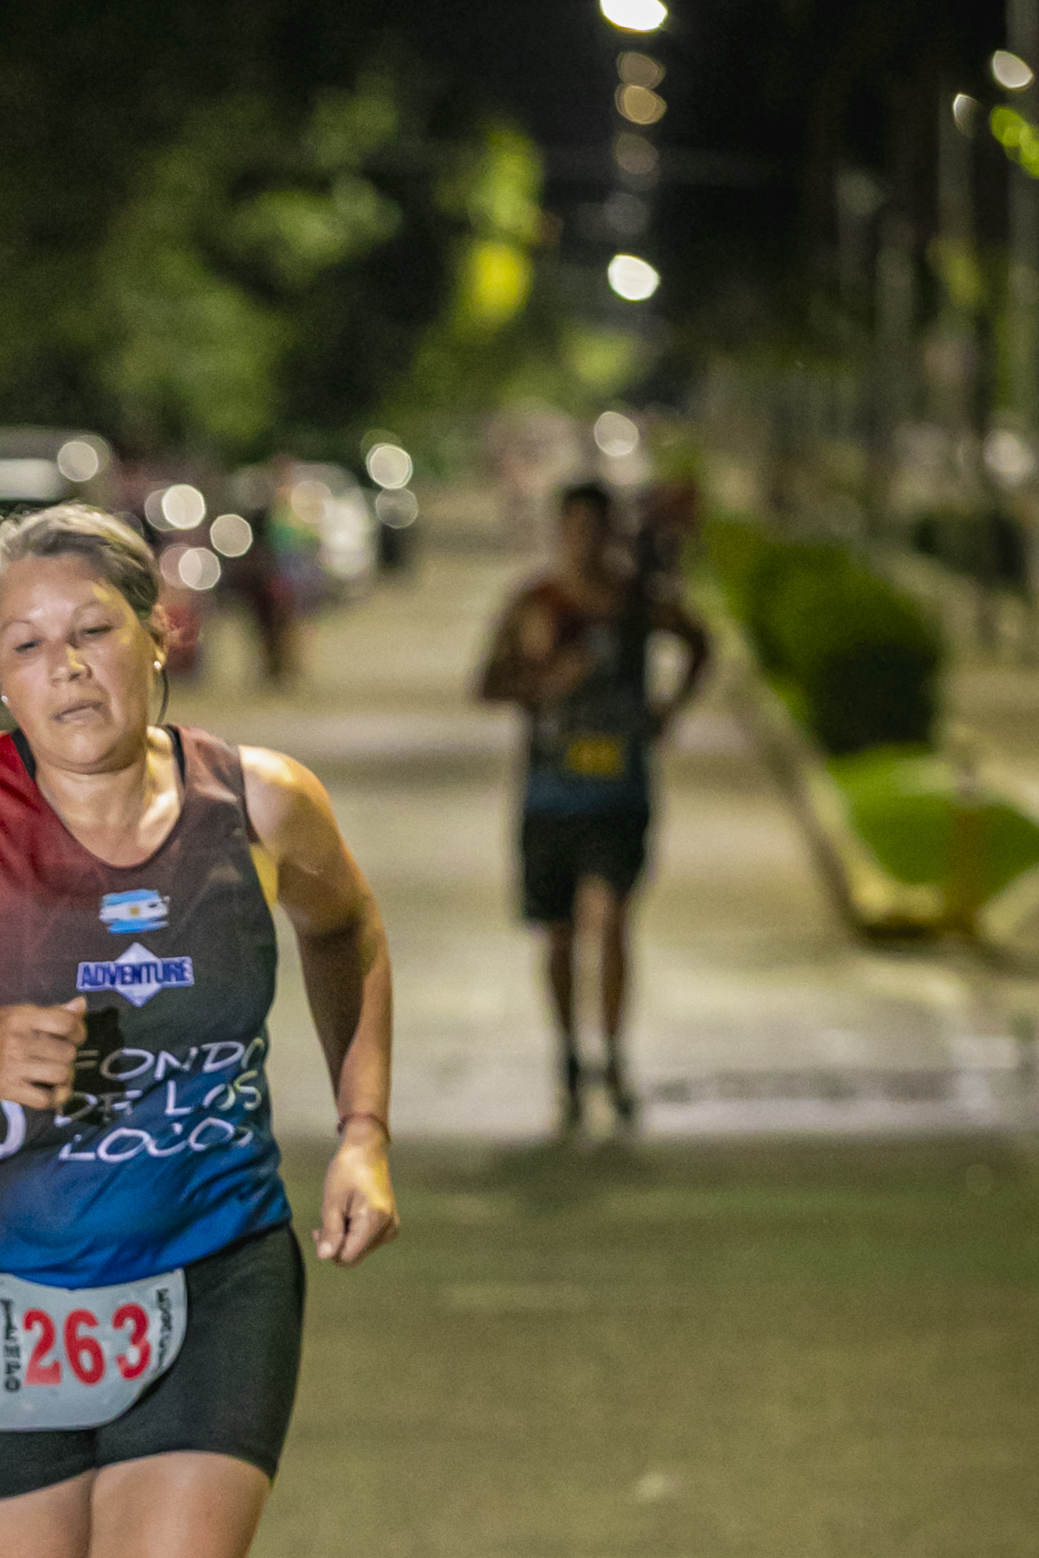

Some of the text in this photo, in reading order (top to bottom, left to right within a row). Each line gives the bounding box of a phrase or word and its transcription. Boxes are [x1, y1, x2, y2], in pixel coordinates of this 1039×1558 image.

[81, 961, 190, 986] ADVENTURE
[165, 1069, 262, 1117] LOS
[22, 1303, 153, 1386] 263
